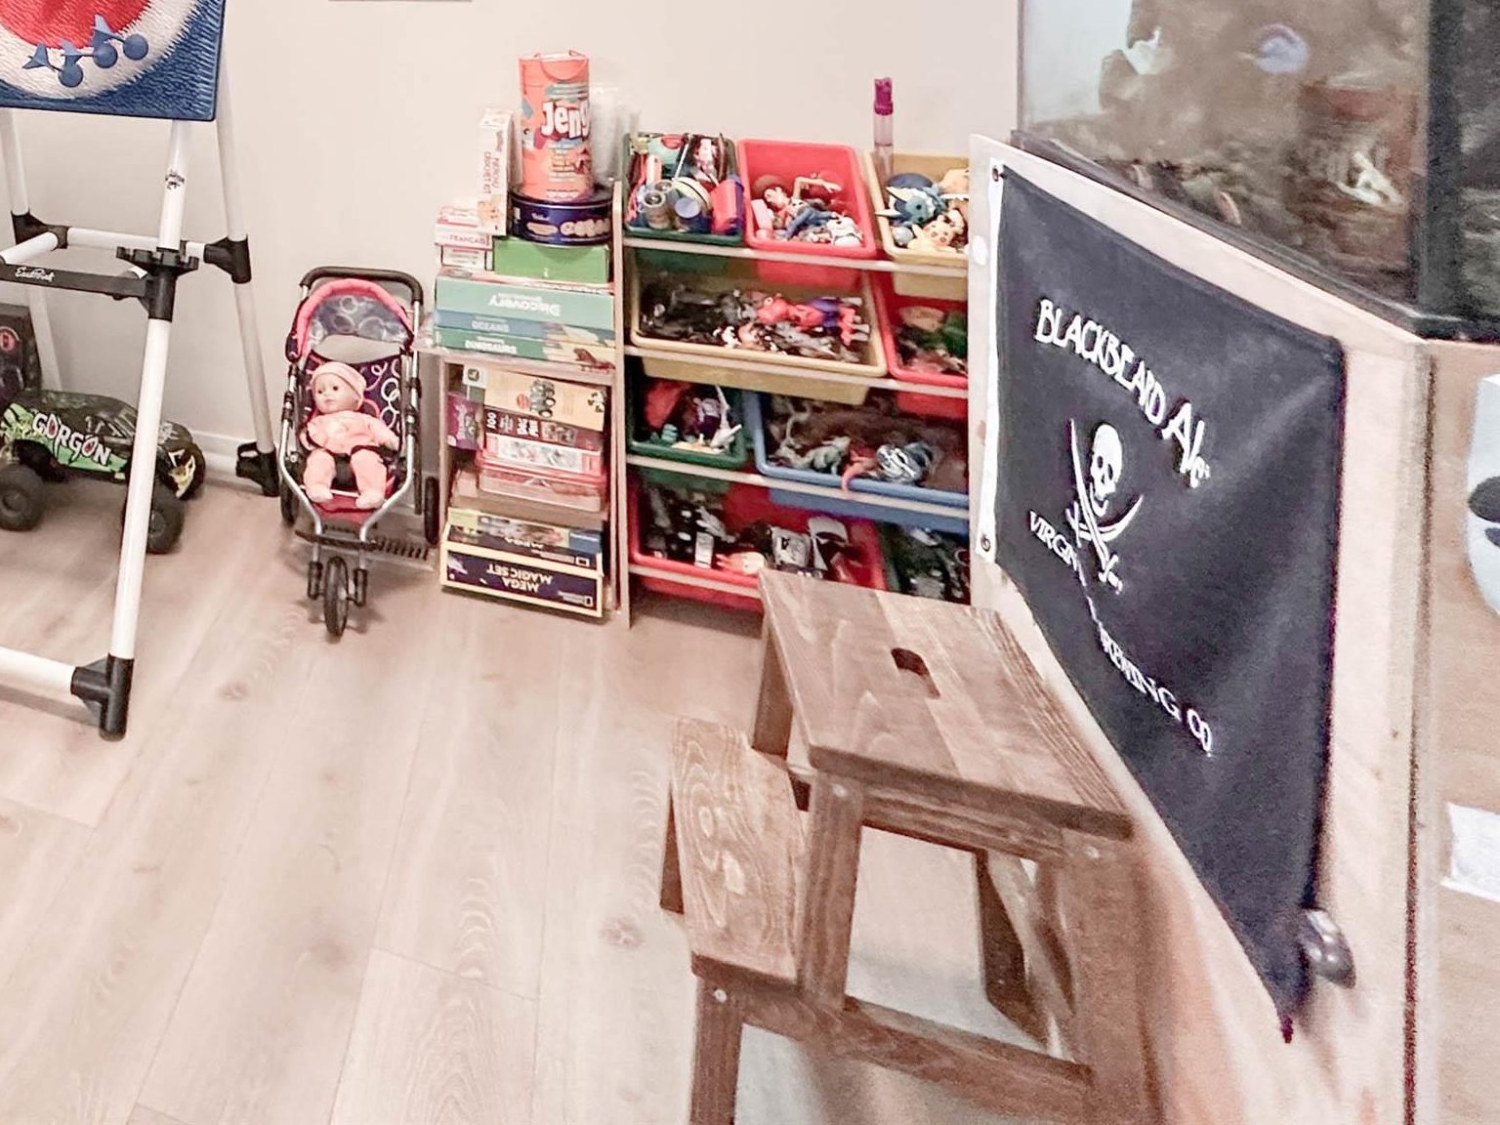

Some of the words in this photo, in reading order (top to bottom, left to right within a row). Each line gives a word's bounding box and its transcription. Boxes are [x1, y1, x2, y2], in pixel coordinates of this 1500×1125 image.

[1034, 299, 1166, 425] BLACKBEARD
[32, 409, 112, 466] GORGON
[486, 563, 510, 577] SET
[510, 566, 554, 585] MAGIC
[502, 577, 540, 593] MEGA
